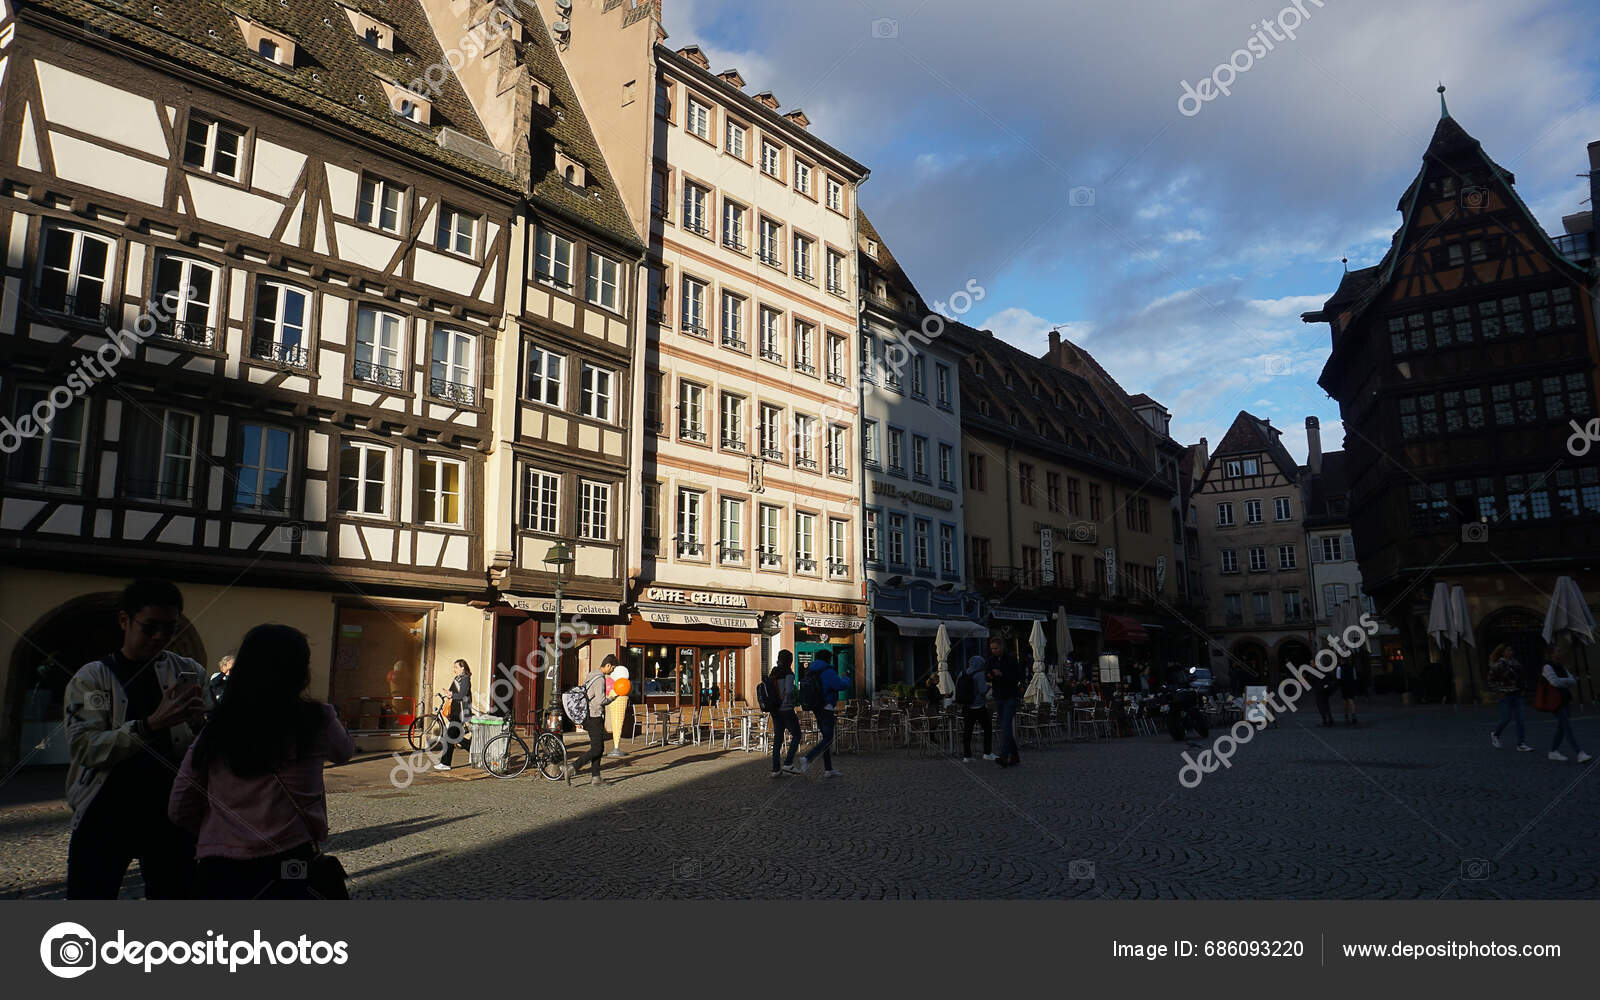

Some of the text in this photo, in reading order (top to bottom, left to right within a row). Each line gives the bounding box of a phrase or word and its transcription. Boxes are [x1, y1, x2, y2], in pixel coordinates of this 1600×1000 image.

[542, 602, 564, 612] Glae
[576, 604, 612, 614] Gelateria
[650, 613, 748, 628] CAFE BAR GELATERIA
[807, 618, 821, 627] CAFE
[848, 621, 861, 630] BAR
